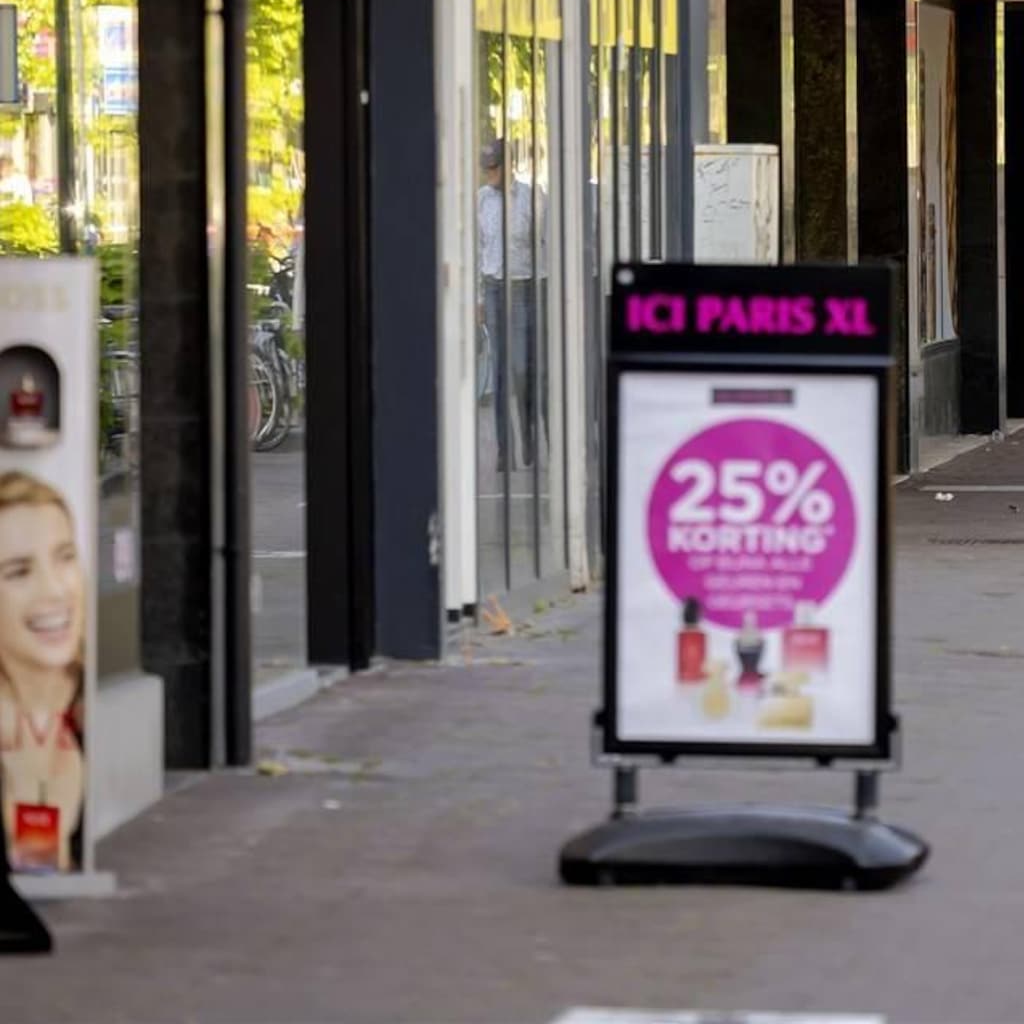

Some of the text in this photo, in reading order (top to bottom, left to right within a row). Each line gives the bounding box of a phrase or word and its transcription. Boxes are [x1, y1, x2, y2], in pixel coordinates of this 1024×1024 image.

[626, 294, 876, 336] ICI PARIS XL
[666, 458, 836, 526] 25%
